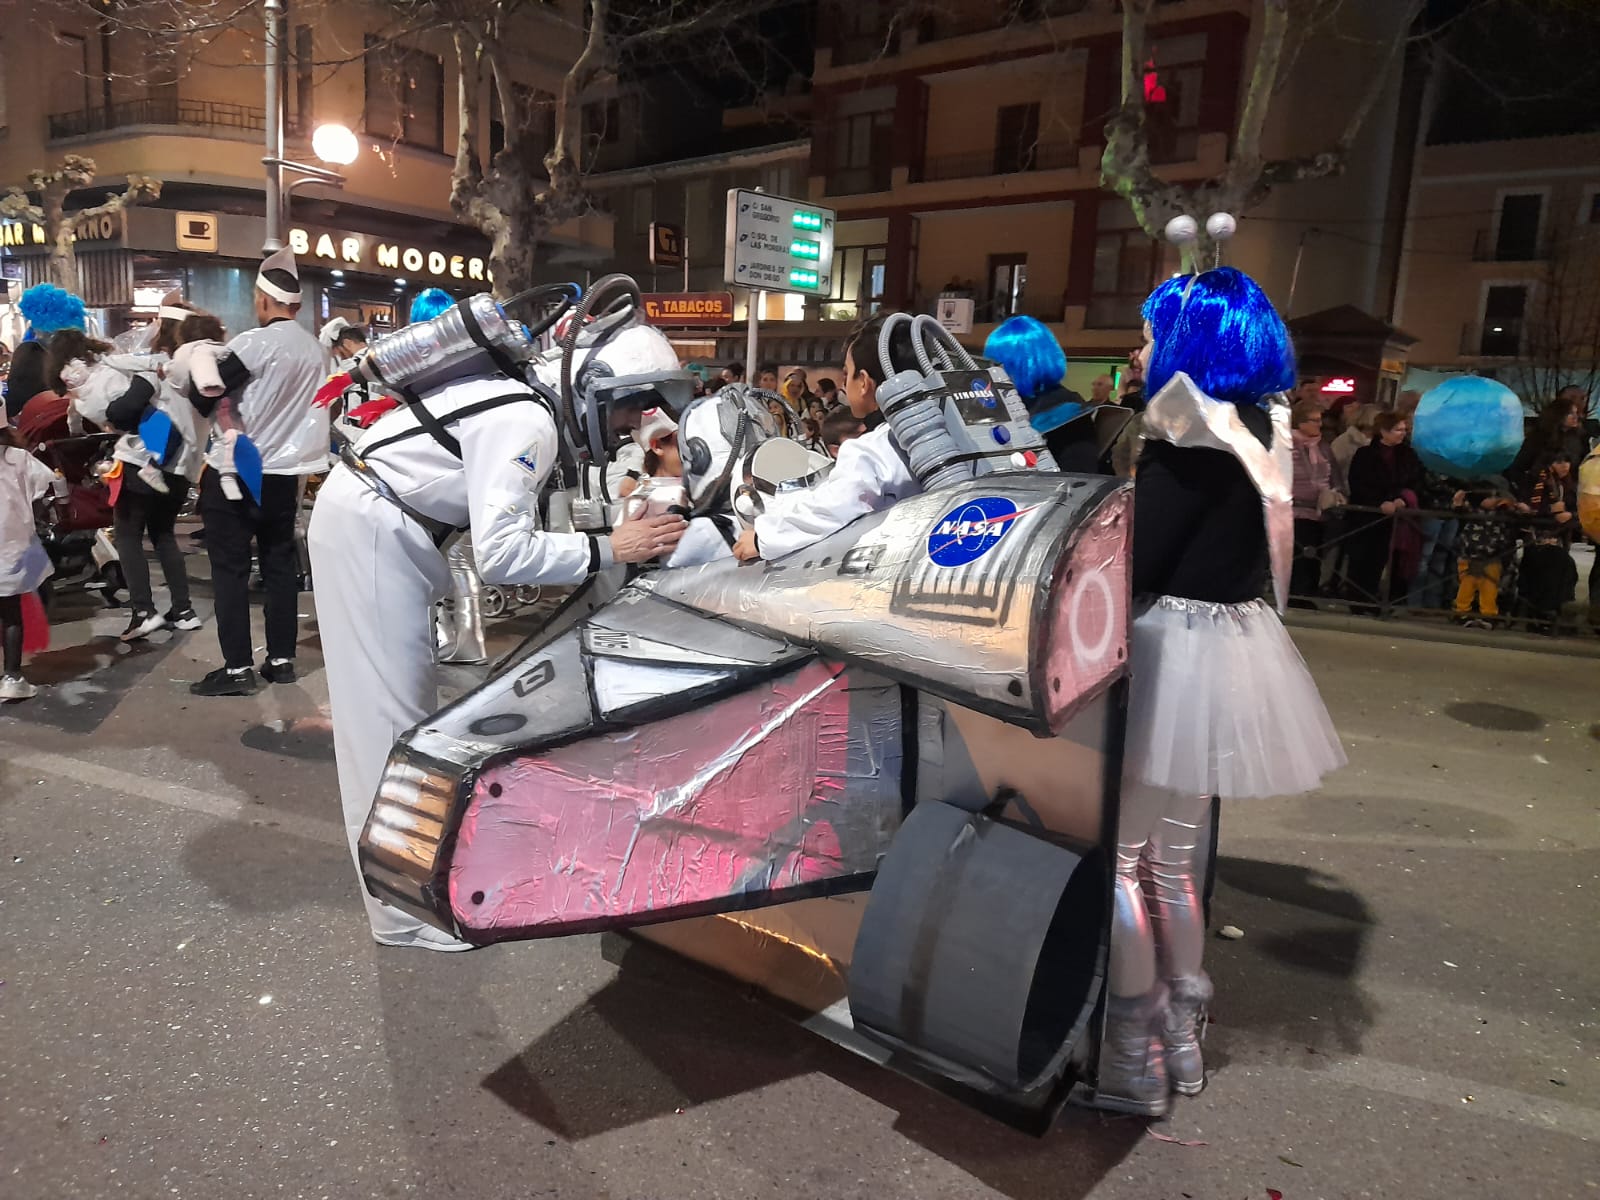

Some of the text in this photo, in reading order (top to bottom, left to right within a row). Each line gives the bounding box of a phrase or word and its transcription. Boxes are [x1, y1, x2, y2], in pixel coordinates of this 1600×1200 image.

[0, 222, 24, 246] AR
[750, 241, 762, 249] LAS
[289, 228, 493, 282] BAR MODER
[662, 300, 722, 313] TABACOS
[936, 520, 1004, 537] NASA
